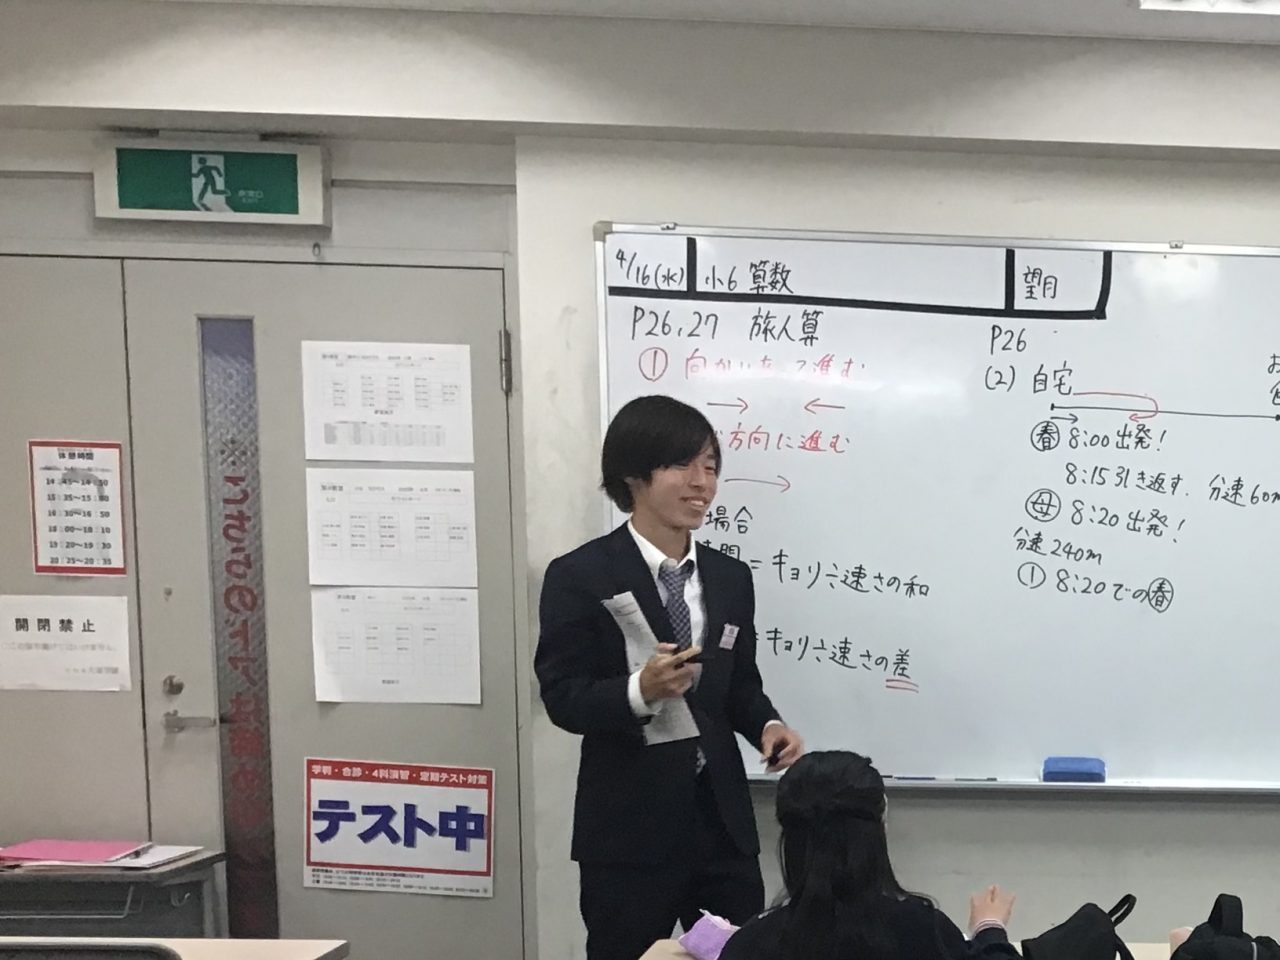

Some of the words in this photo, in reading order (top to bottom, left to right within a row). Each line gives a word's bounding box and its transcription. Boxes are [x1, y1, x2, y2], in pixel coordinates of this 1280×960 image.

[705, 266, 738, 291] 小6
[749, 260, 794, 293] 算数
[1022, 266, 1058, 300] 望月
[749, 306, 824, 346] 旅人算
[990, 325, 1027, 355] P26
[985, 365, 1016, 392] (2)
[1033, 360, 1074, 394] 自宅
[705, 505, 753, 534] 場合
[15, 618, 96, 633] 開閉禁止
[312, 799, 487, 853] テスト中
